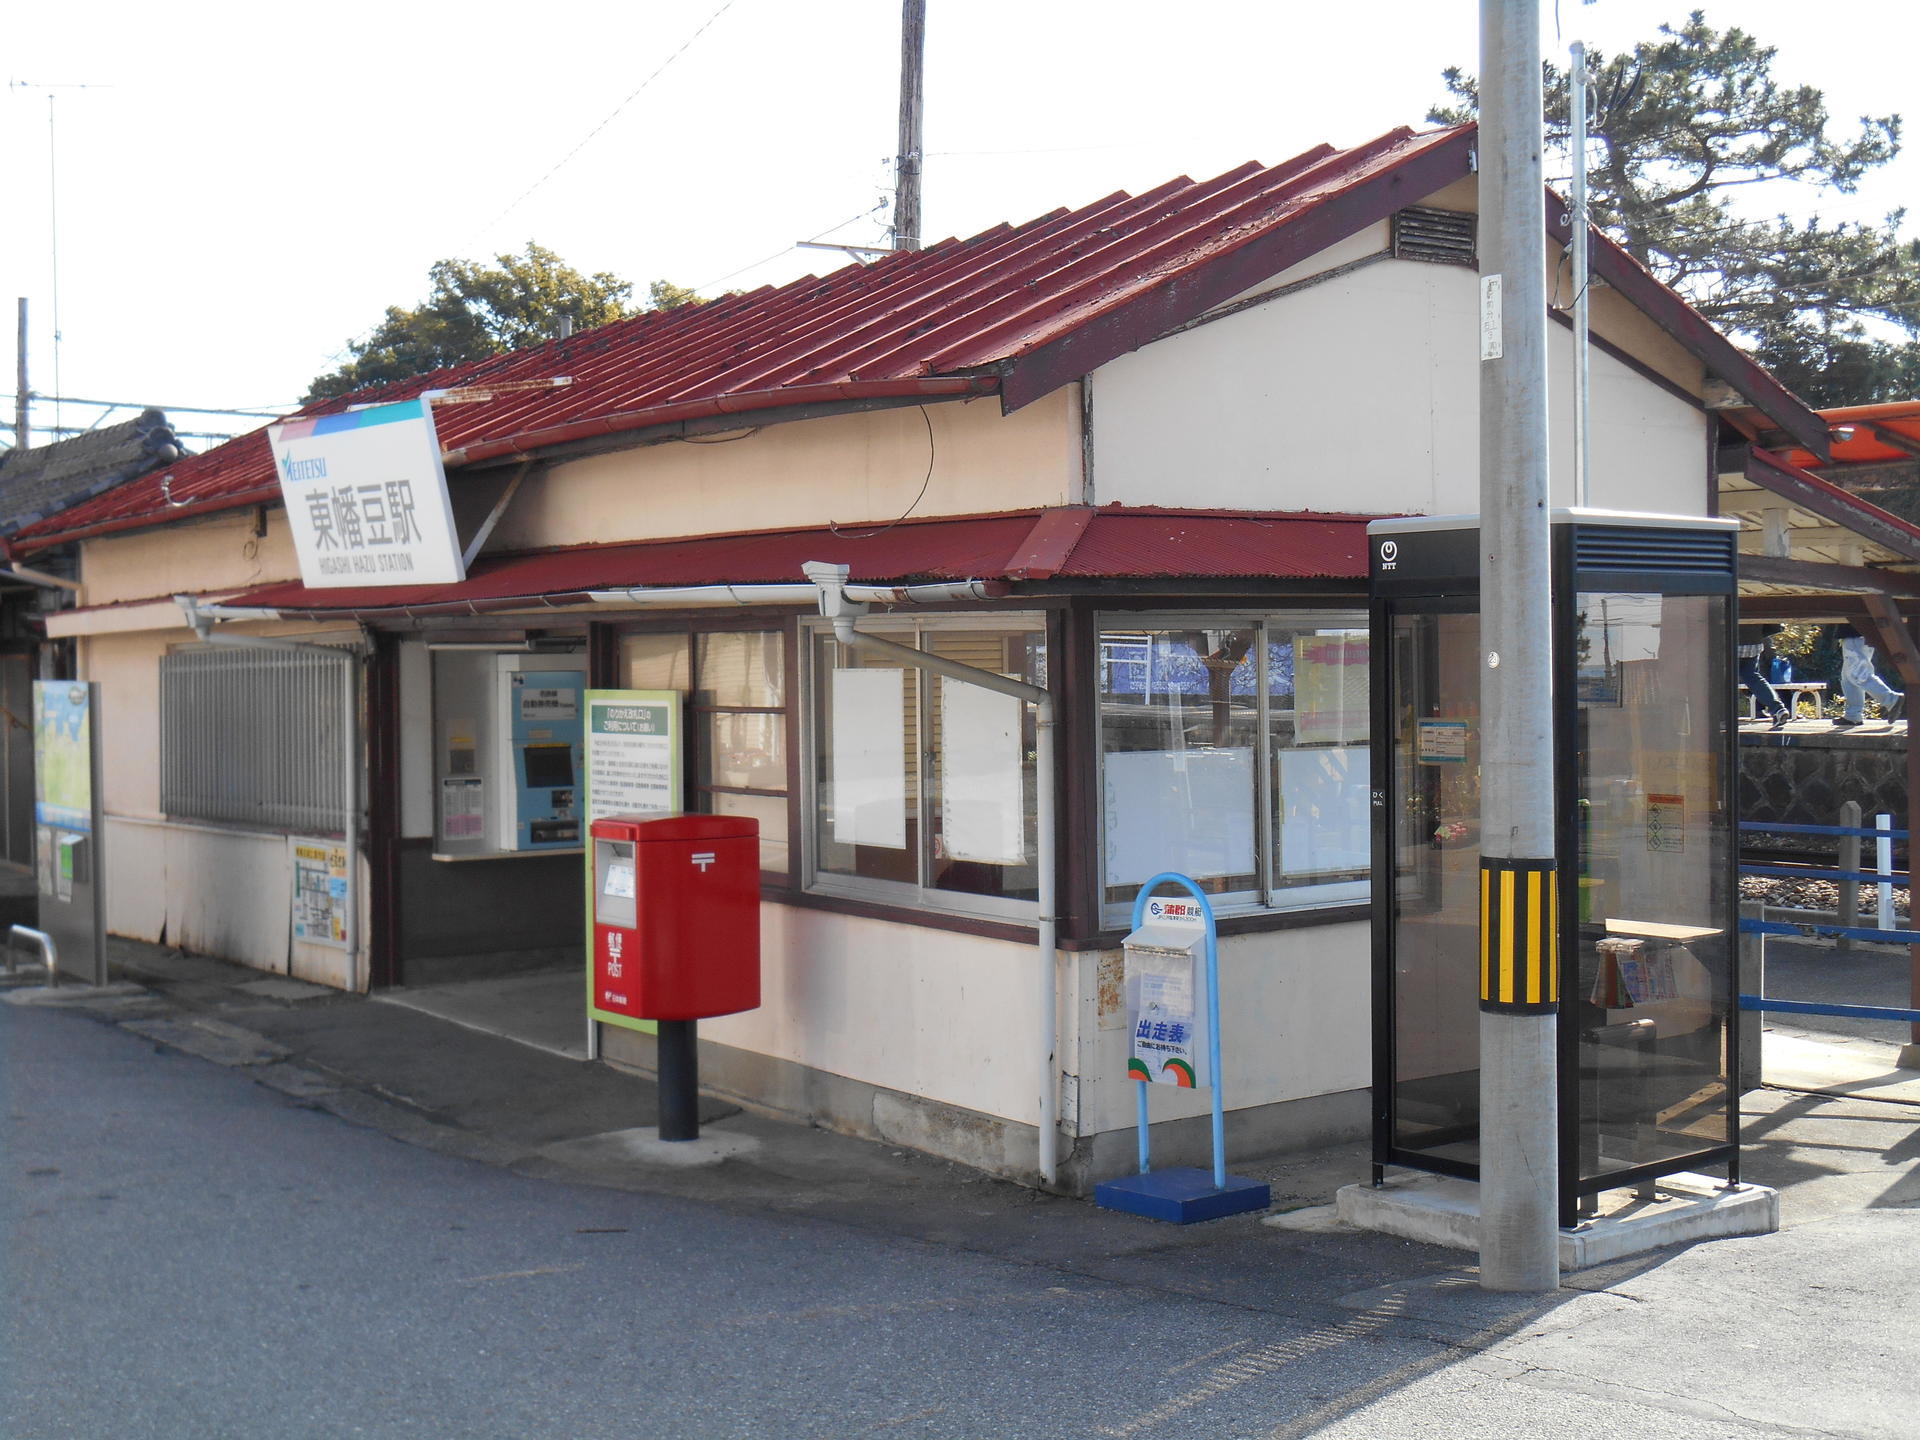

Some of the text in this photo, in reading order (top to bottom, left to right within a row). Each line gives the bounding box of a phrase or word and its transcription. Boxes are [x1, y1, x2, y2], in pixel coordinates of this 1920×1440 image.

[282, 451, 327, 481] MEITETSU
[305, 479, 422, 552] 東幡豆駅
[319, 551, 415, 575] HIGASHI HAZU STATION
[1382, 562, 1397, 570] NTT
[607, 962, 622, 978] POST
[1136, 1019, 1184, 1043] 出走表
[1137, 1040, 1188, 1056] ご自由にお持ち下さい。
